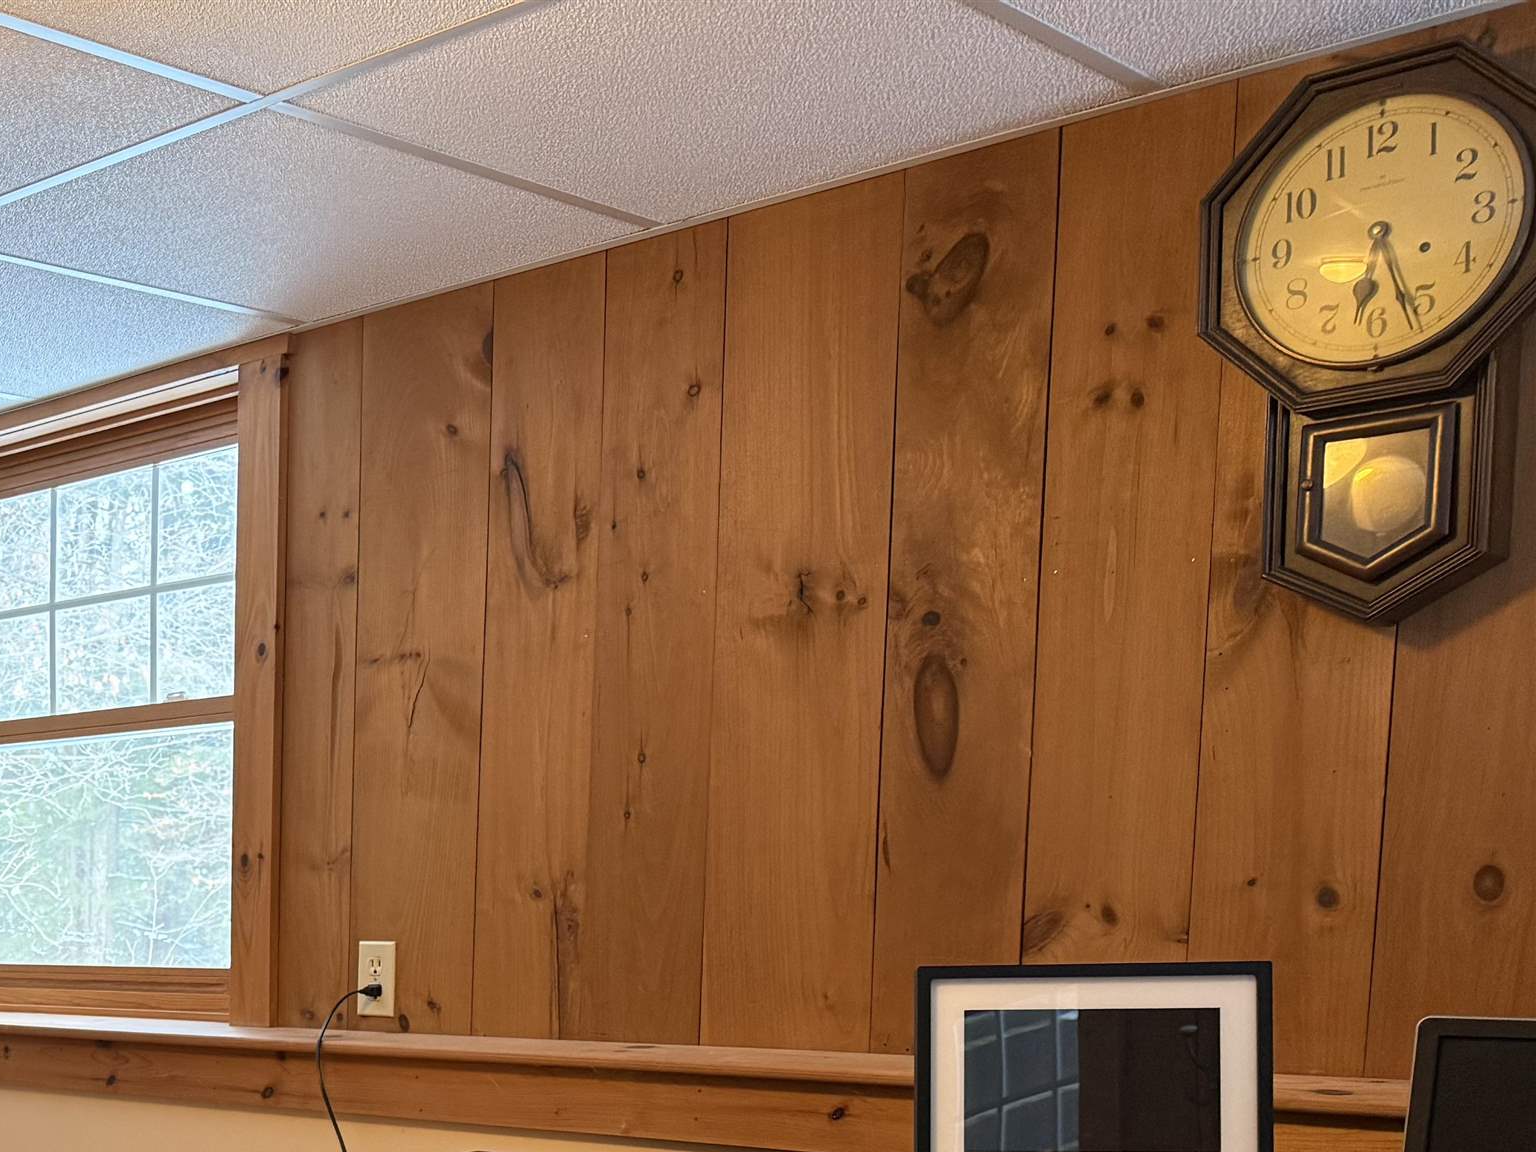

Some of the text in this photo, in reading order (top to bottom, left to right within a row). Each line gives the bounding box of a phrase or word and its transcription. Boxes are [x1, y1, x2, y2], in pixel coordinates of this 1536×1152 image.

[1367, 120, 1399, 159] 12
[1430, 121, 1438, 156] 1
[1326, 146, 1346, 181] 11
[1454, 147, 1479, 183] 2
[1285, 187, 1317, 223] 10
[1471, 190, 1496, 224] 3
[1271, 238, 1292, 269] 9
[1453, 239, 1477, 274] 4
[1285, 278, 1308, 310] 8
[1413, 281, 1436, 316] 5
[1319, 303, 1340, 334] 7
[1366, 306, 1387, 338] 6
